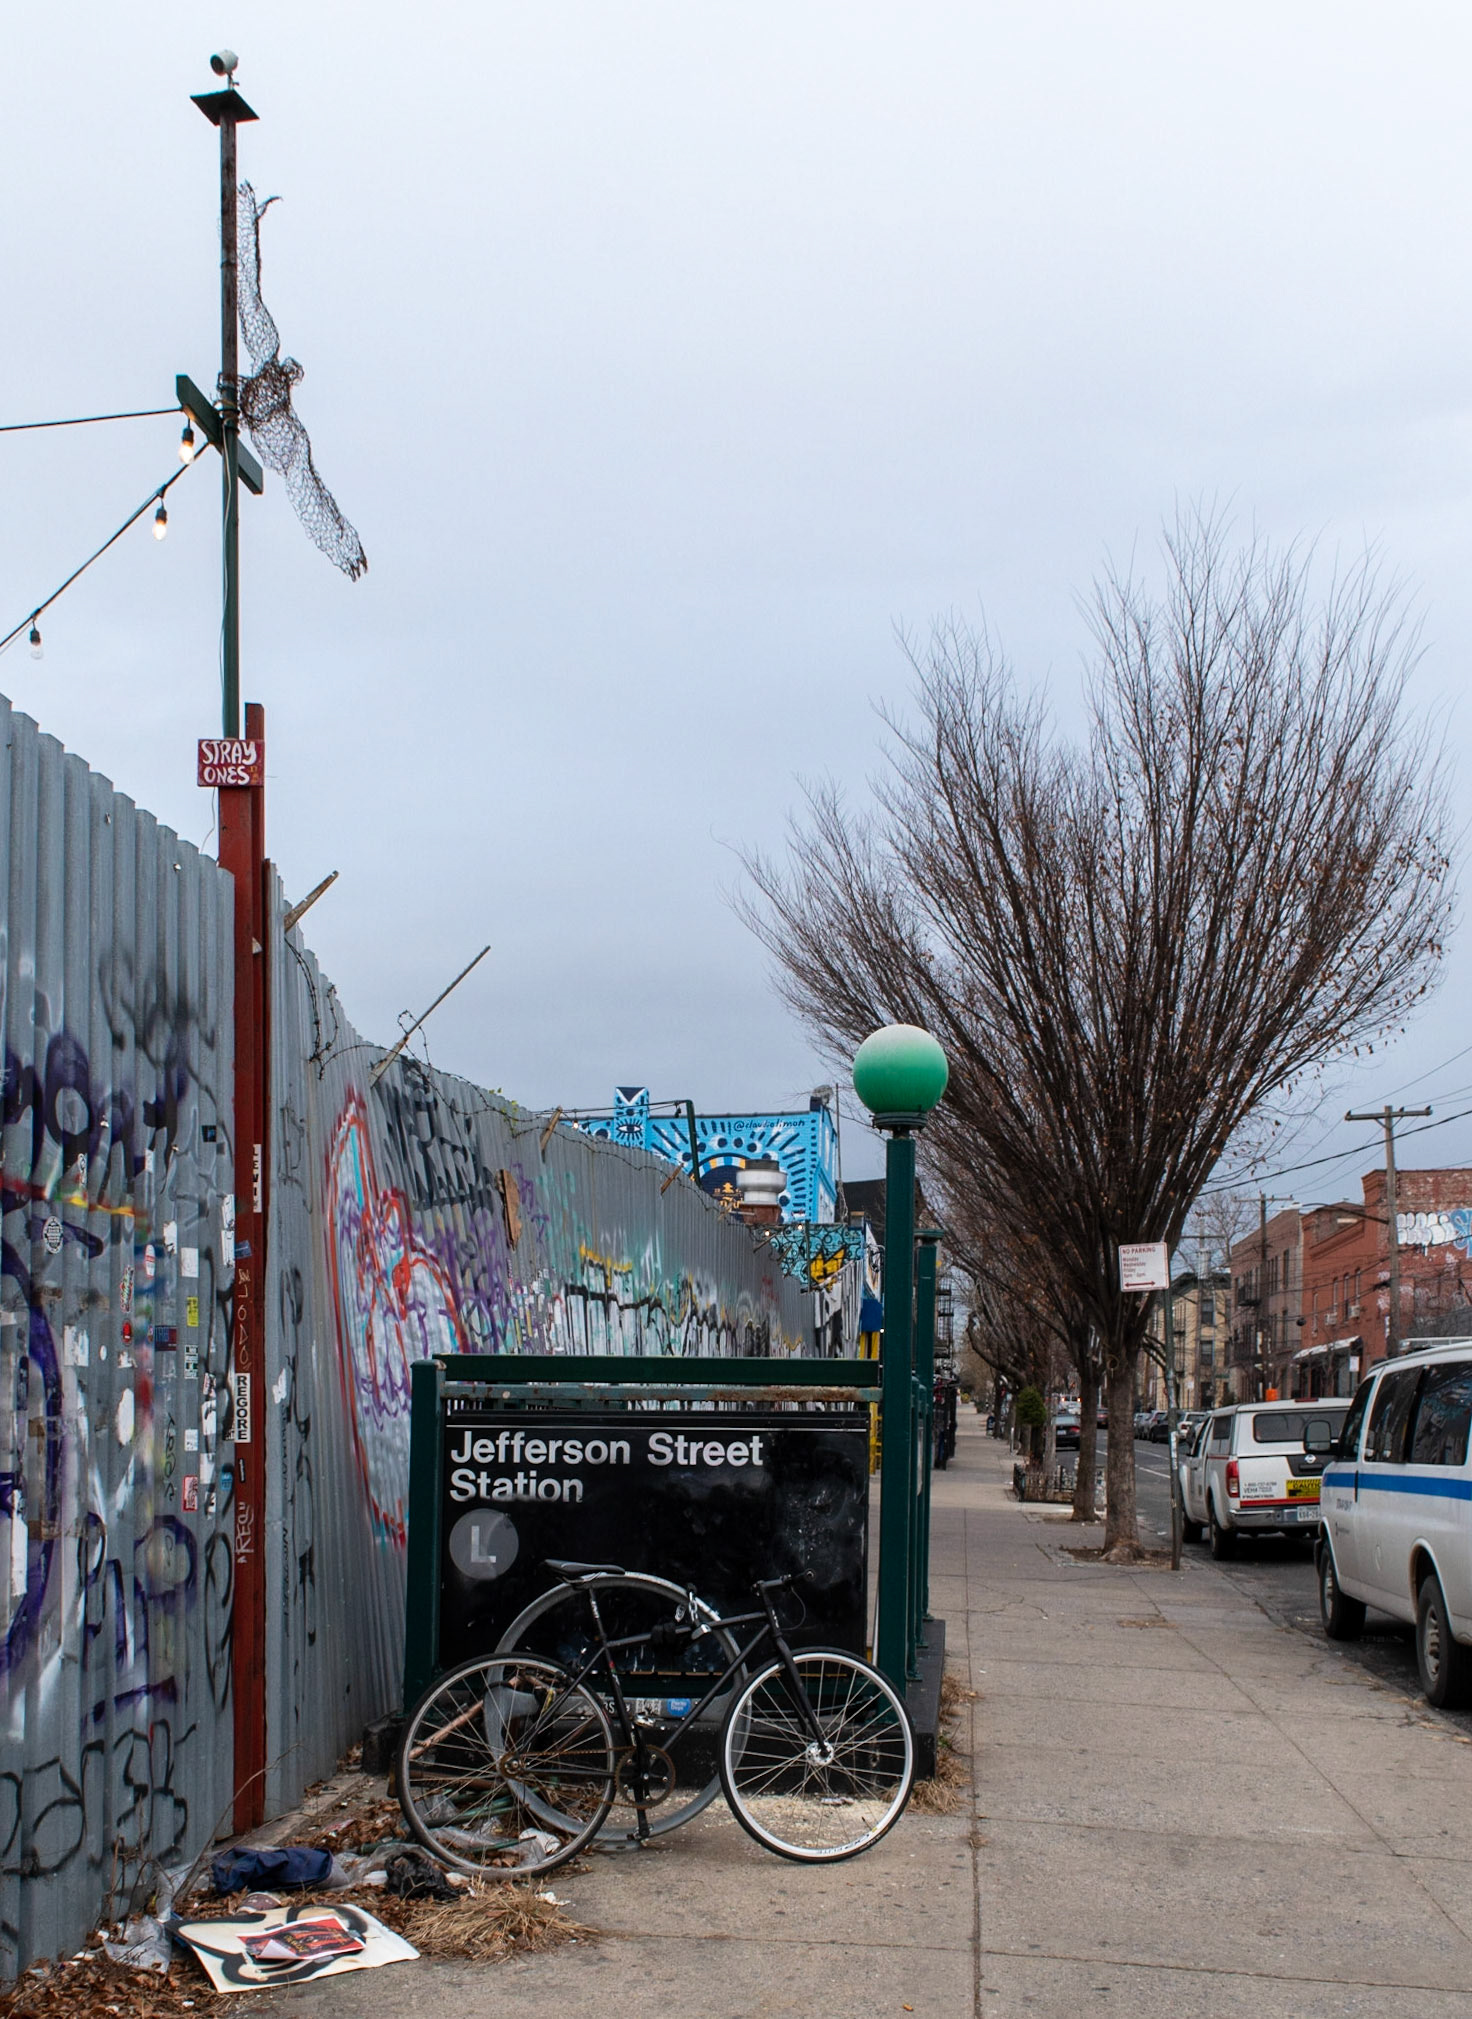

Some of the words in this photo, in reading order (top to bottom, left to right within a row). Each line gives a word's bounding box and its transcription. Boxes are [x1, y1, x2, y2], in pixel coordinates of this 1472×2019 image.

[201, 741, 257, 766] STRAY
[203, 766, 250, 785] ONES
[237, 1375, 248, 1441] REGORE
[450, 1431, 630, 1464] Jefferson
[648, 1432, 763, 1466] Street
[450, 1468, 583, 1503] Station
[471, 1526, 497, 1563] L
